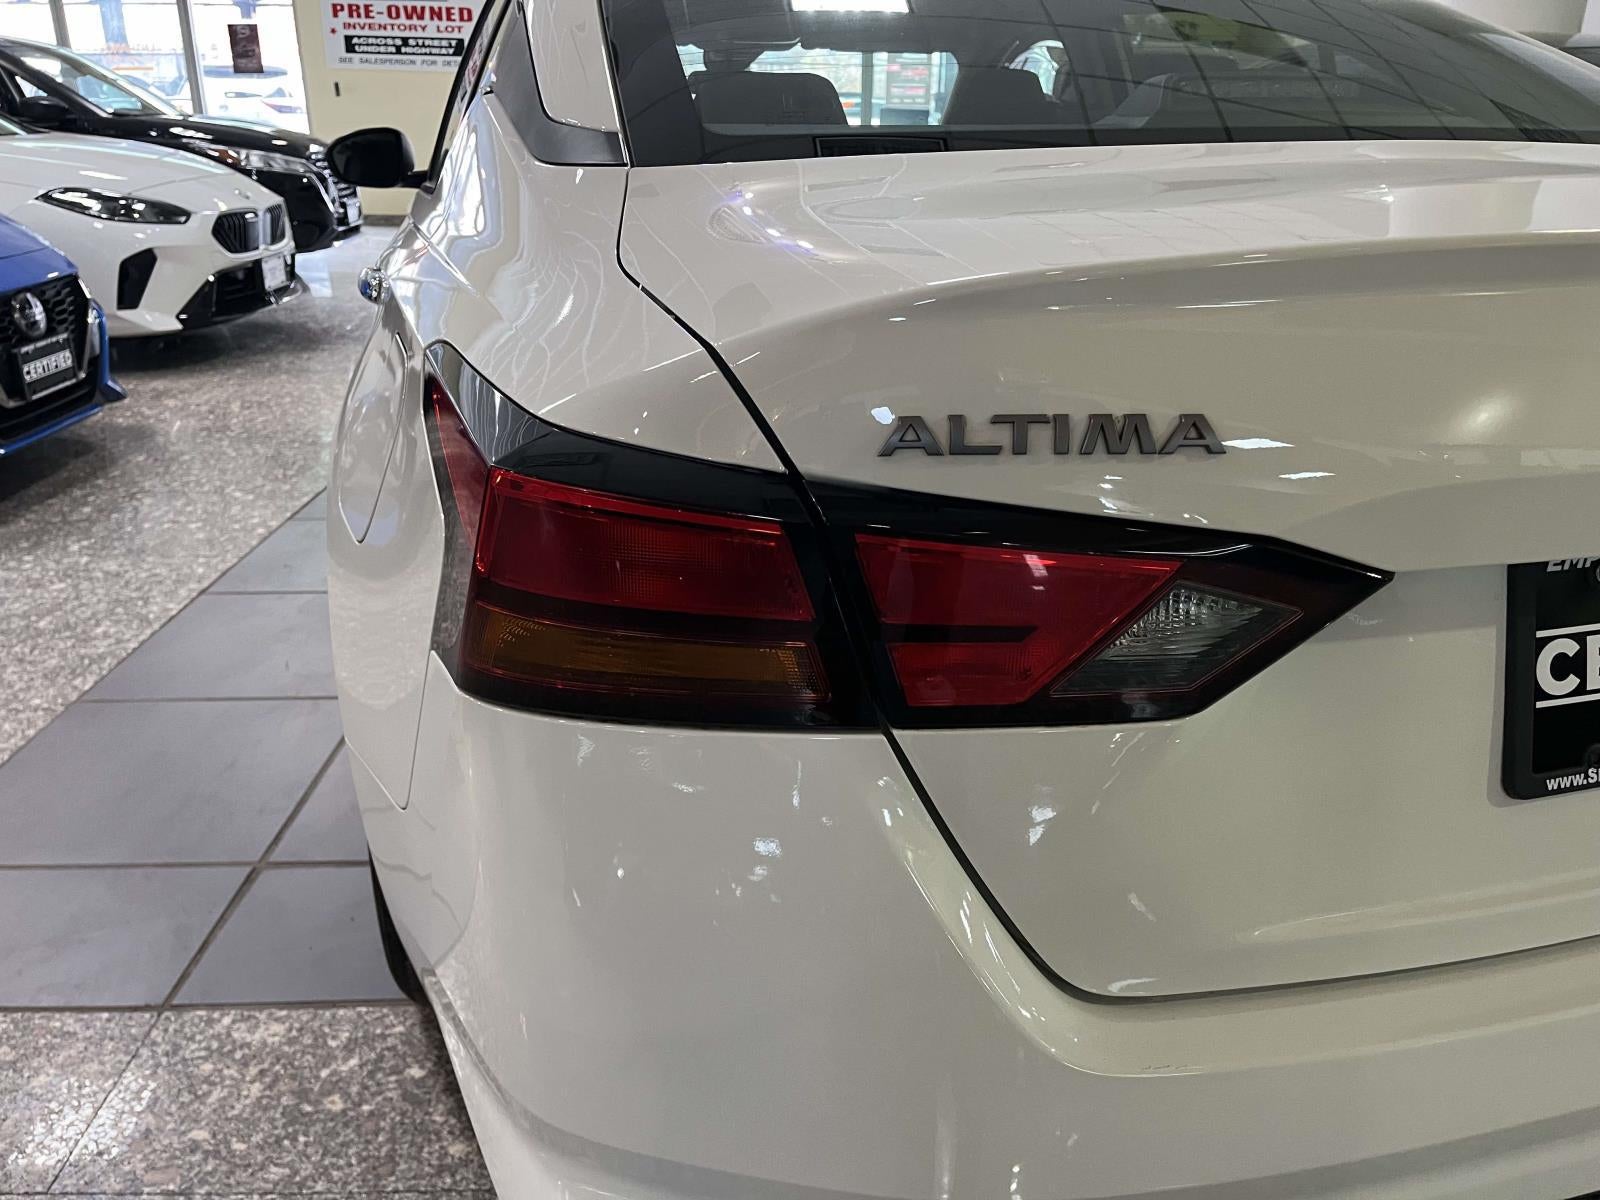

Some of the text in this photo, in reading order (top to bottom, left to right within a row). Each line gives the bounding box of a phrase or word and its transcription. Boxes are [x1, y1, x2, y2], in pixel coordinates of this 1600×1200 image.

[331, 3, 473, 22] PRE-OWNED
[343, 22, 464, 34] INVENTORY LOT
[351, 37, 458, 47] ACROSS STREET
[354, 45, 455, 55] UNDER HIGHWAY
[23, 350, 73, 381] CERTIFIED
[877, 413, 1227, 457] ALTIMA
